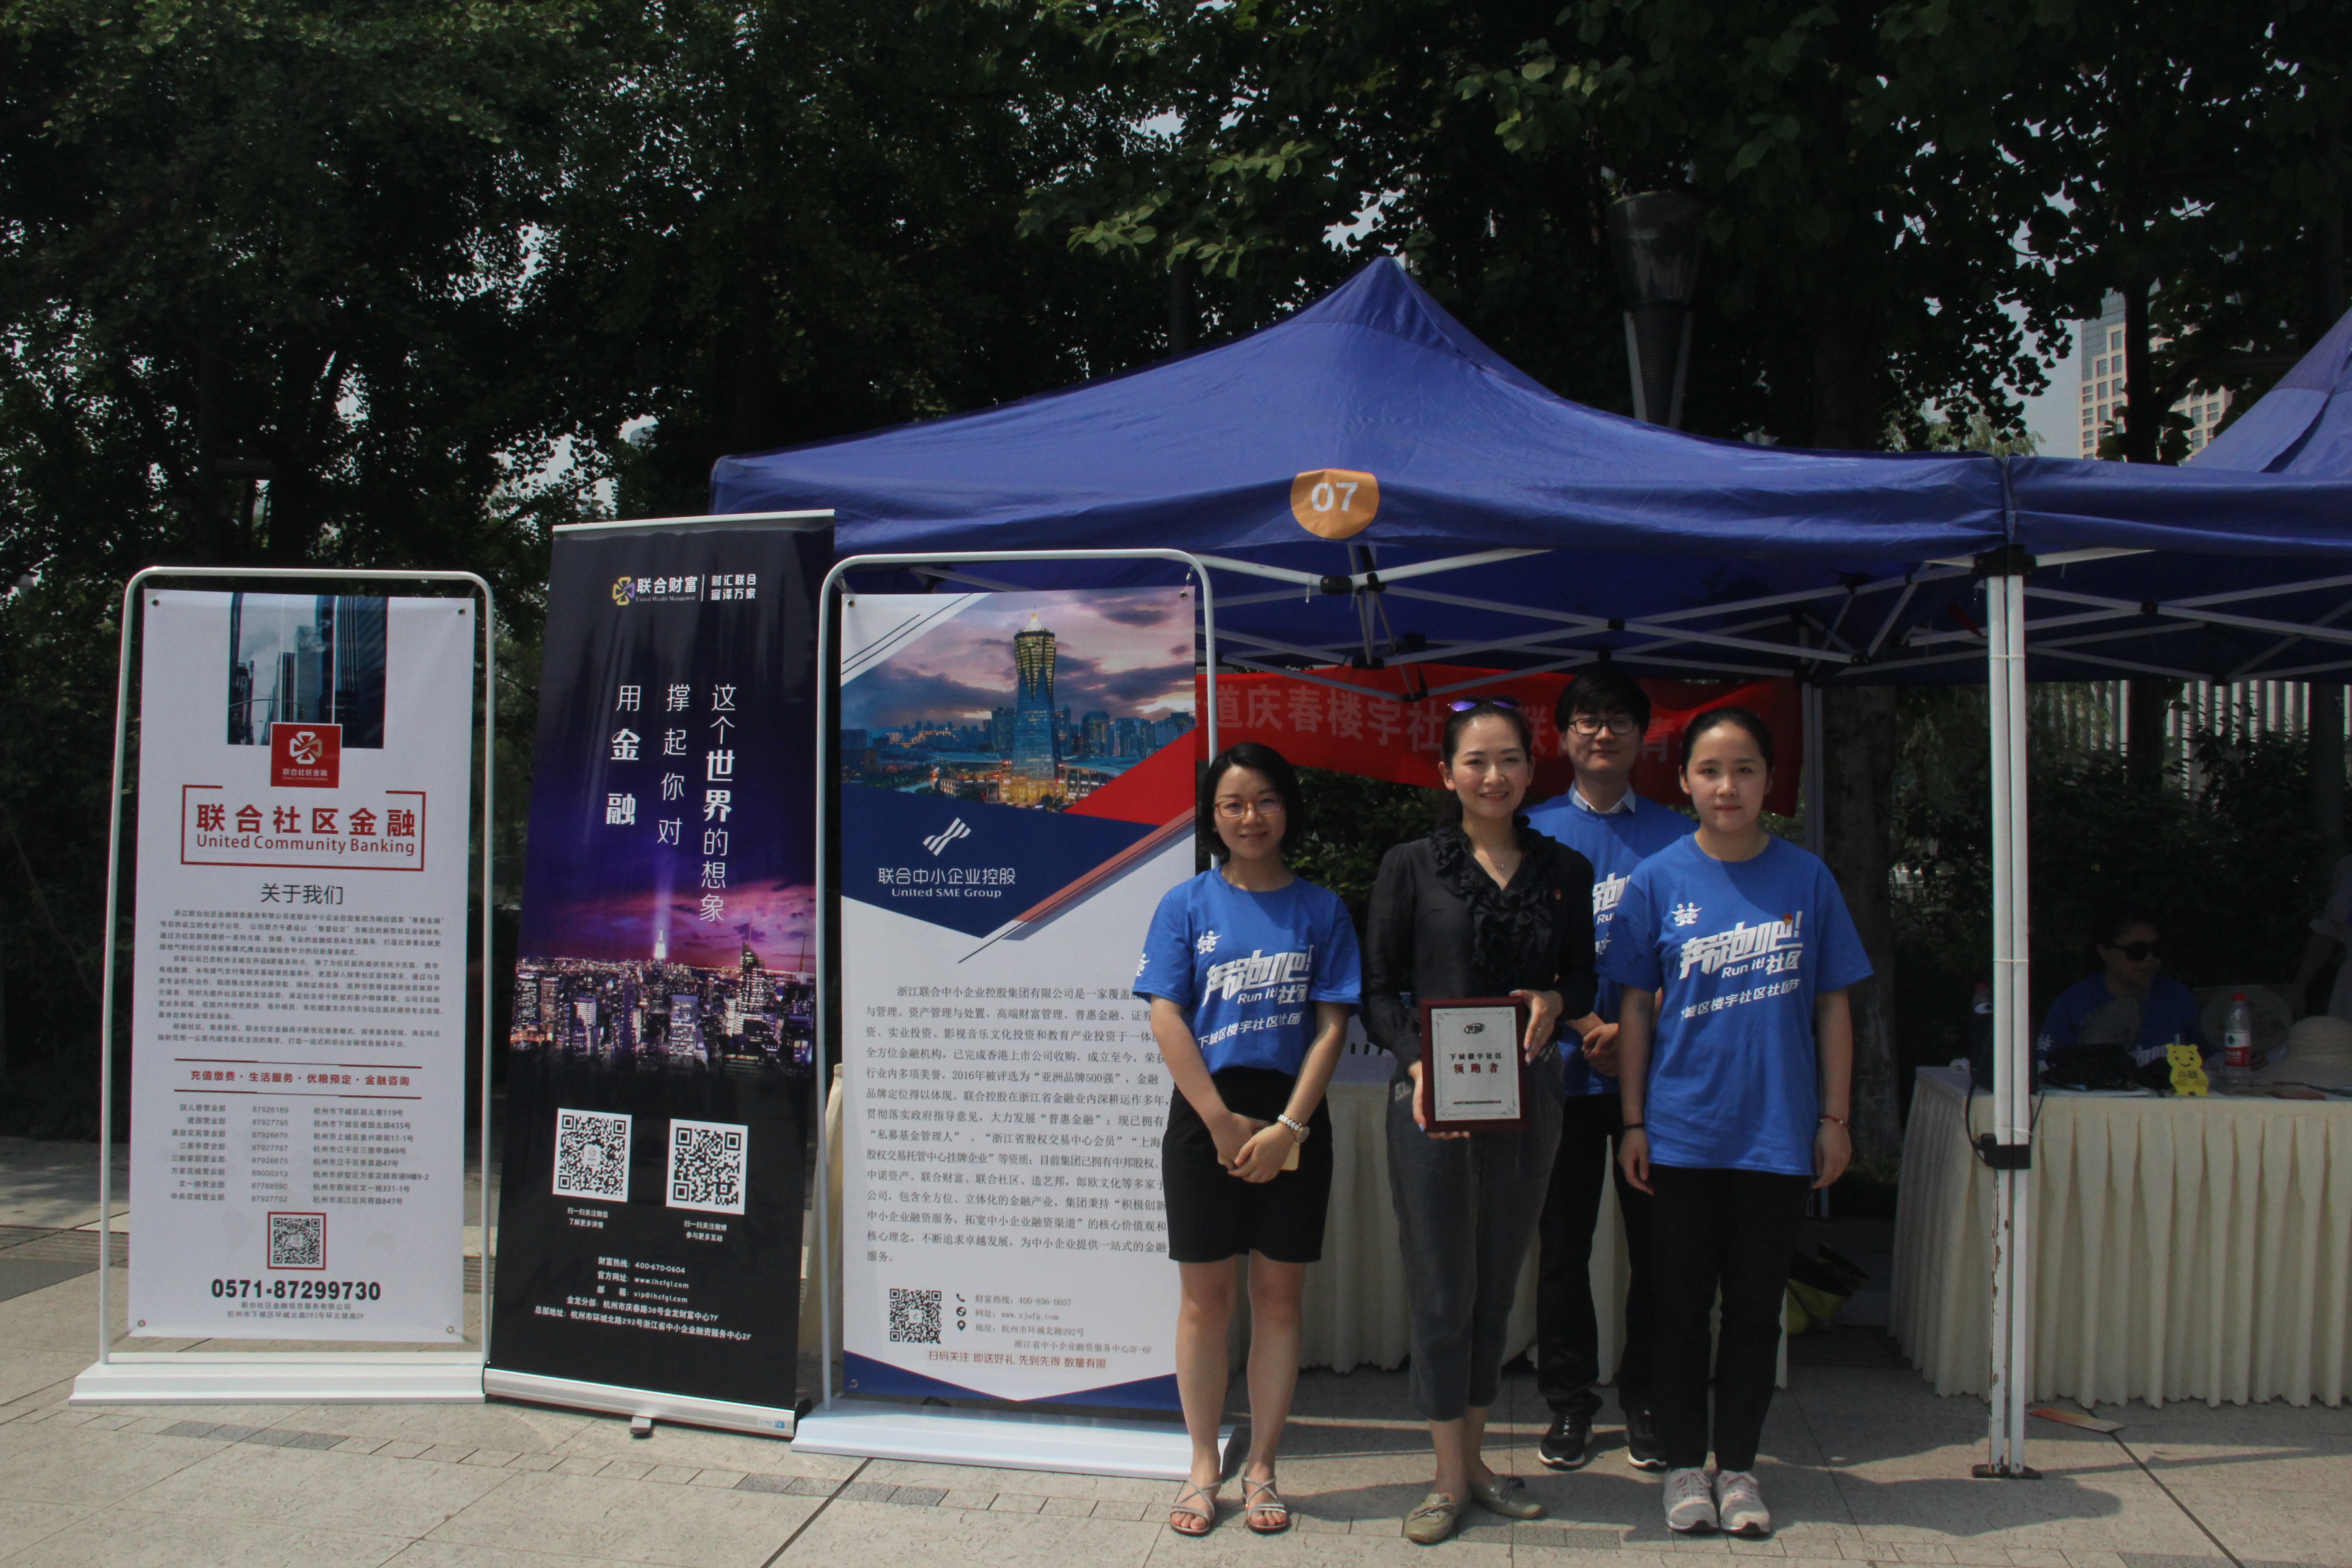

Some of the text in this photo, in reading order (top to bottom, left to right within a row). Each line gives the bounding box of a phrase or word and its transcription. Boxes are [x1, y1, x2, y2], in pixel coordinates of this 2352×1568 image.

[1311, 482, 1358, 512] 07
[636, 576, 698, 594] 联合财富
[711, 574, 757, 586] 财汇联合
[710, 588, 756, 600] 富泽万家
[606, 685, 641, 826] 用金融
[657, 684, 690, 845] 撑起你对
[282, 768, 328, 777] 联合社区金融
[699, 684, 737, 921] 这个世界的想象
[197, 803, 415, 837] 联合社区金融
[197, 834, 414, 856] United Community Banking
[878, 868, 1016, 885] 联合中小企业控股
[261, 883, 344, 906] 关于我们
[892, 888, 1002, 898] United SME Group
[1722, 964, 1749, 979] Run
[1751, 957, 1765, 970] it!
[1237, 993, 1262, 1004] Run
[1265, 987, 1278, 999] it!
[866, 1026, 1158, 1043] 资、实业投资、影视音乐文化投资和教育产业投资于一体
[1198, 1011, 1303, 1049] 下城区楼宇社区社团
[867, 1251, 893, 1262] 服务。
[212, 1279, 381, 1301] 0571-87299730
[929, 1350, 1107, 1369] 扫码关注 即送好礼 先到先得 数量有限
